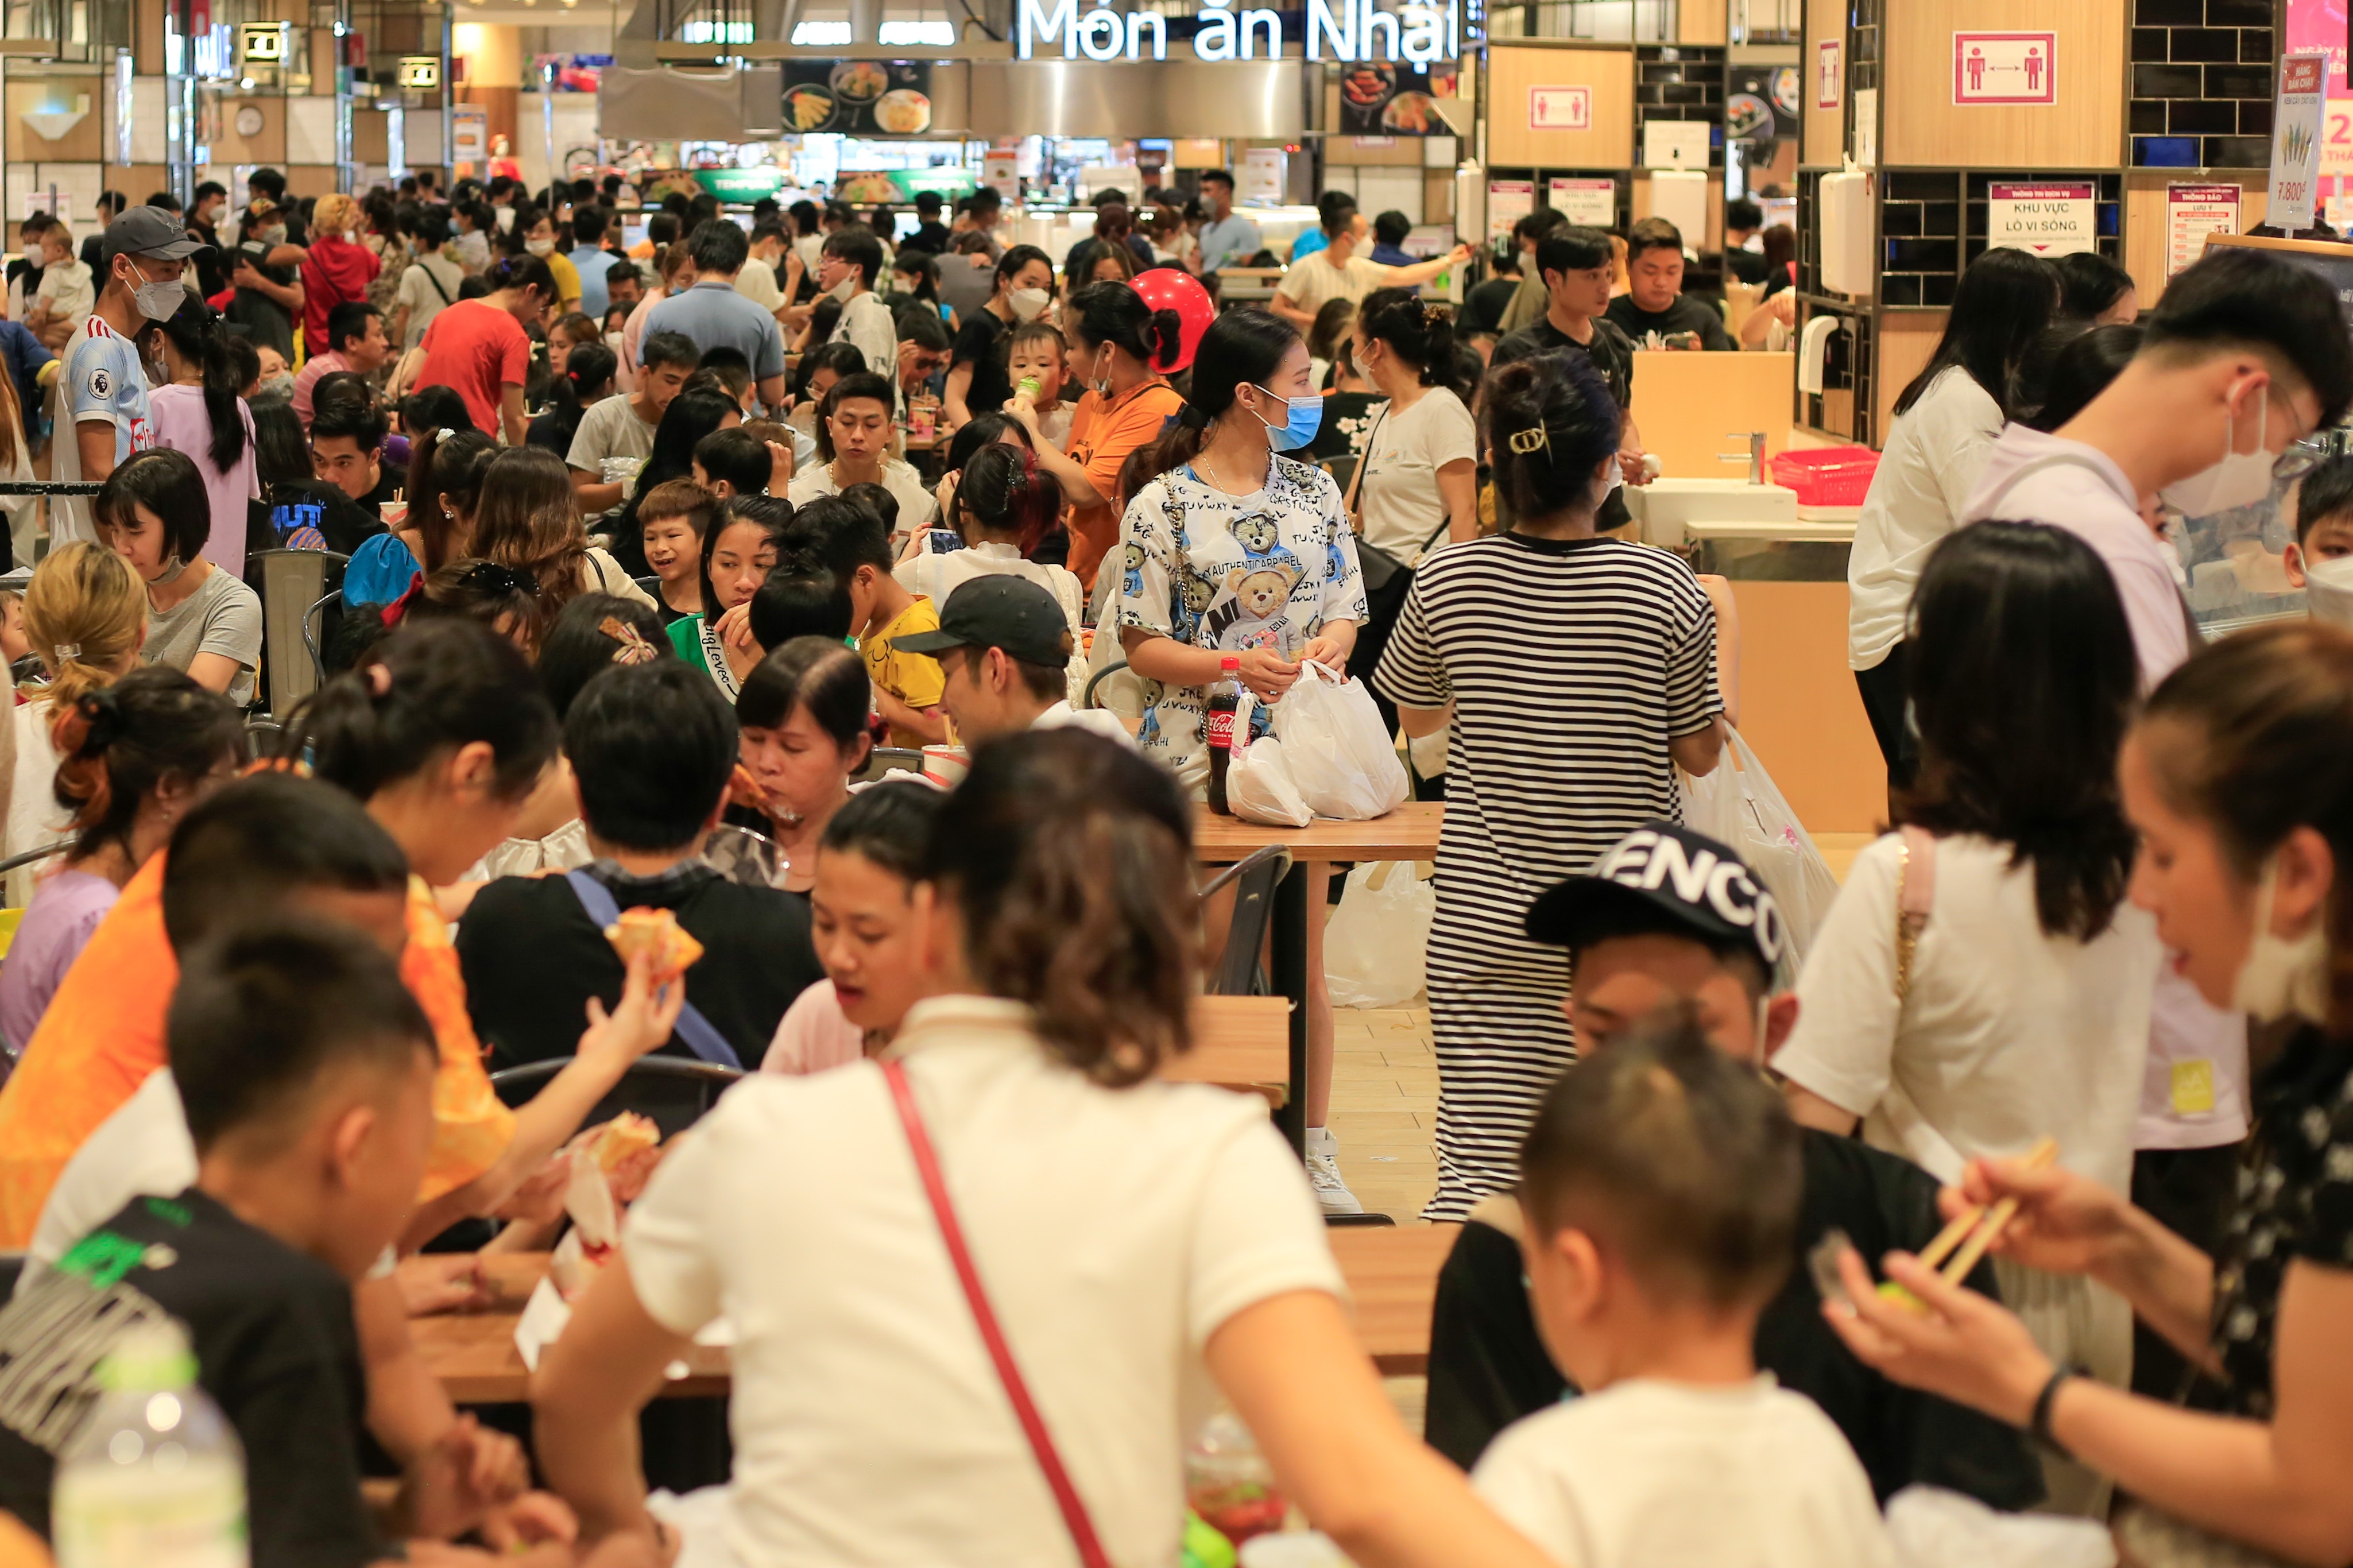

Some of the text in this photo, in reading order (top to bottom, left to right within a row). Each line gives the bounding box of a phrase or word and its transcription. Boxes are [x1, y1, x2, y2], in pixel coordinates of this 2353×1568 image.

[1016, 0, 1168, 61] Món
[1193, 0, 1283, 61] ăn
[1306, 0, 1460, 74] Nhật
[2015, 203, 2069, 215] KHU VỰC
[2006, 218, 2077, 231] LÒ VI SÓNG
